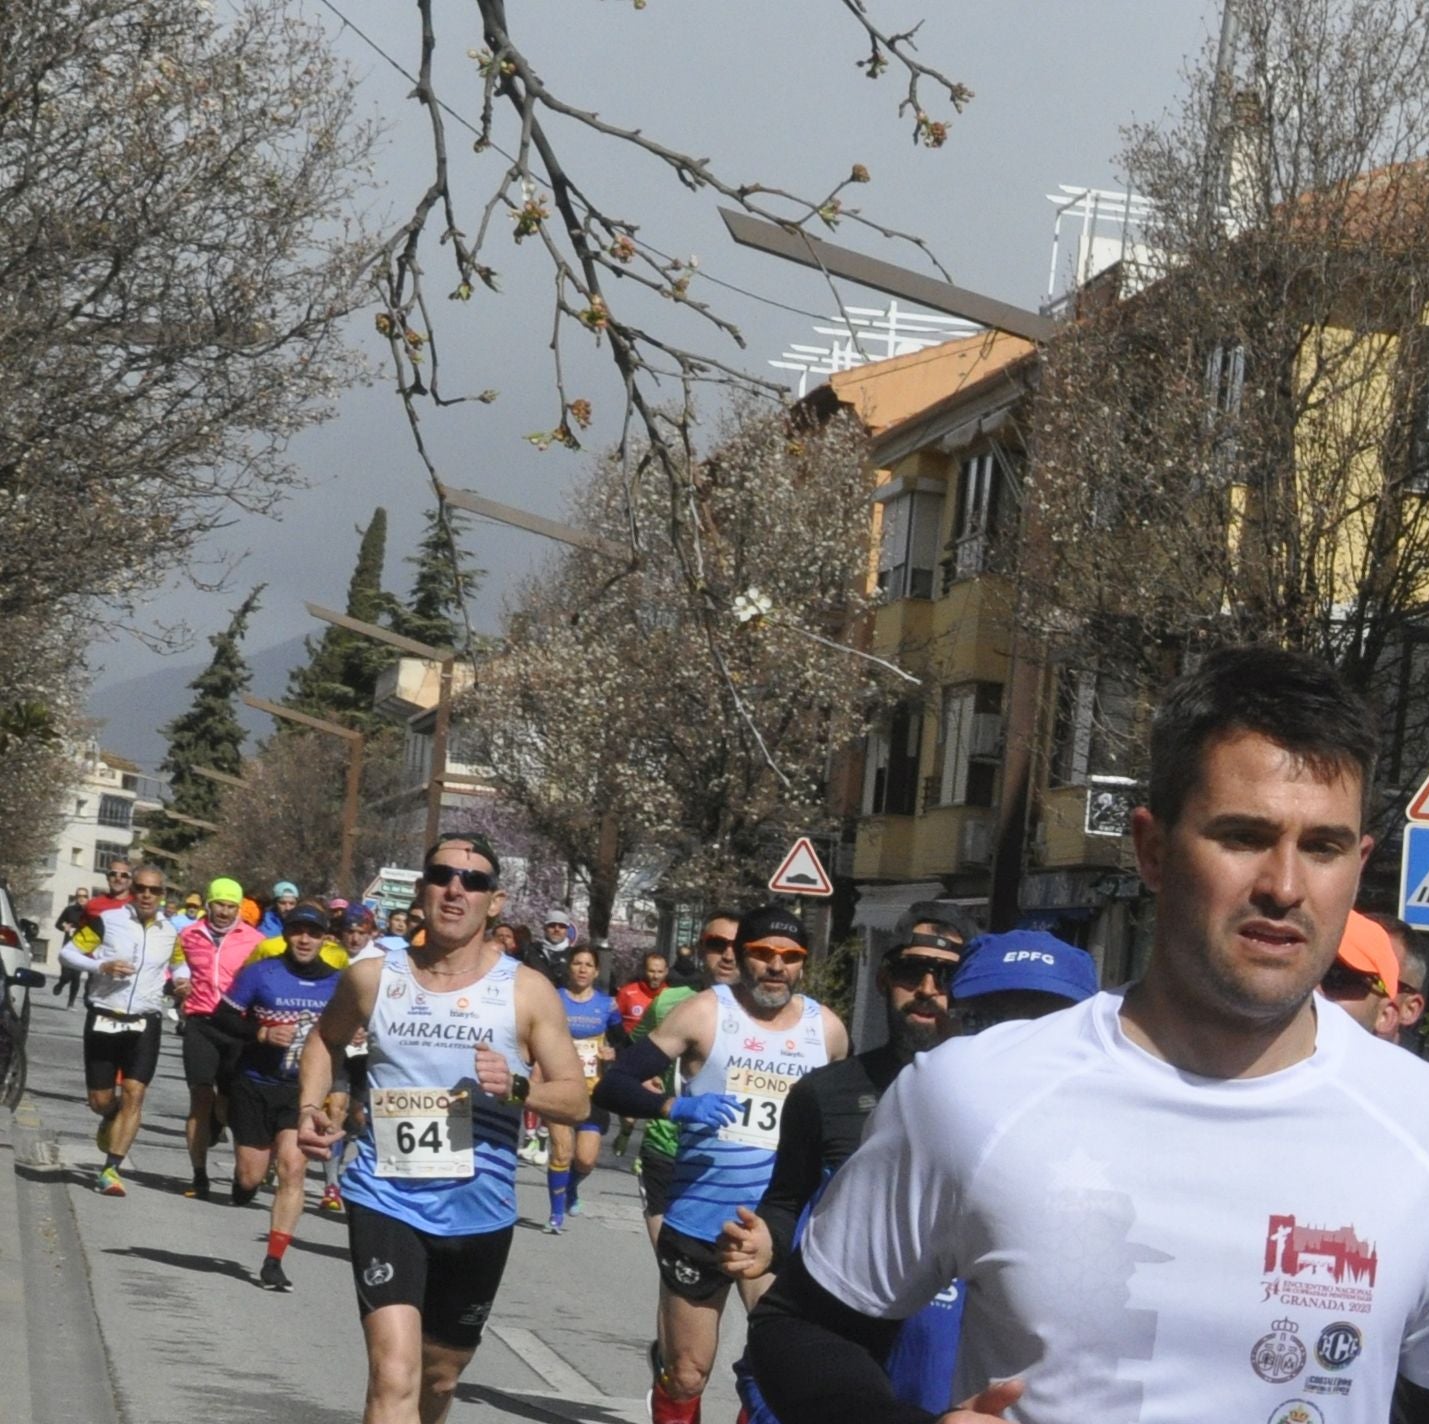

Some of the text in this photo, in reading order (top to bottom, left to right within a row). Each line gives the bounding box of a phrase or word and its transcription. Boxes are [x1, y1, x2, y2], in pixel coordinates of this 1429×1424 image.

[387, 1021, 494, 1043] MARACENA
[397, 1121, 443, 1154] 64
[1280, 1294, 1345, 1311] GRANADA
